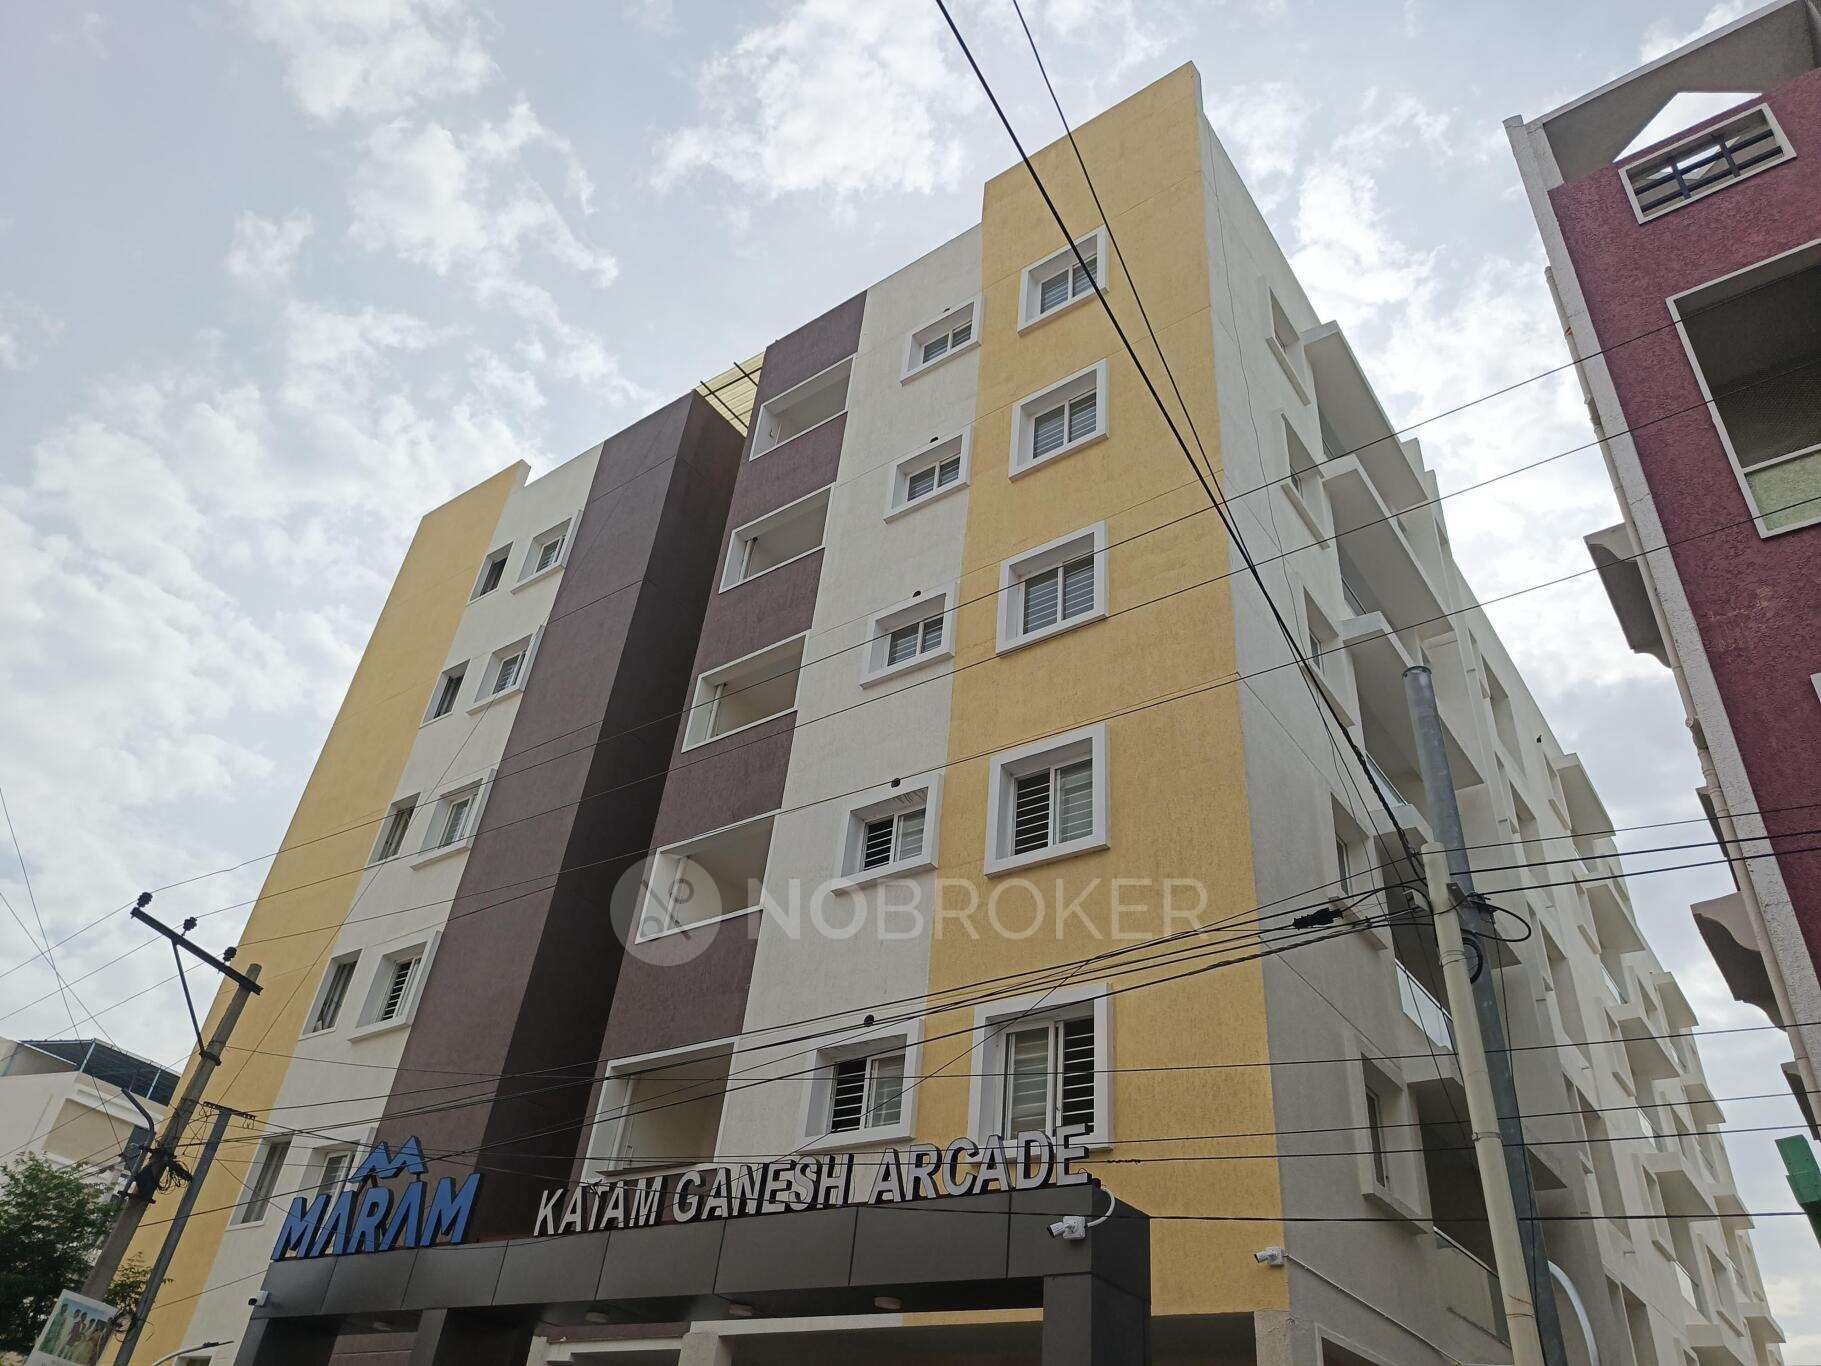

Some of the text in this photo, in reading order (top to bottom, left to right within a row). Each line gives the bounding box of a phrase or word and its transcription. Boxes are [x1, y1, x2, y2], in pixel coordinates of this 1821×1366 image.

[270, 1172, 481, 1261] MARAM
[533, 1123, 1090, 1236] KATAM GANESH ARCADE
